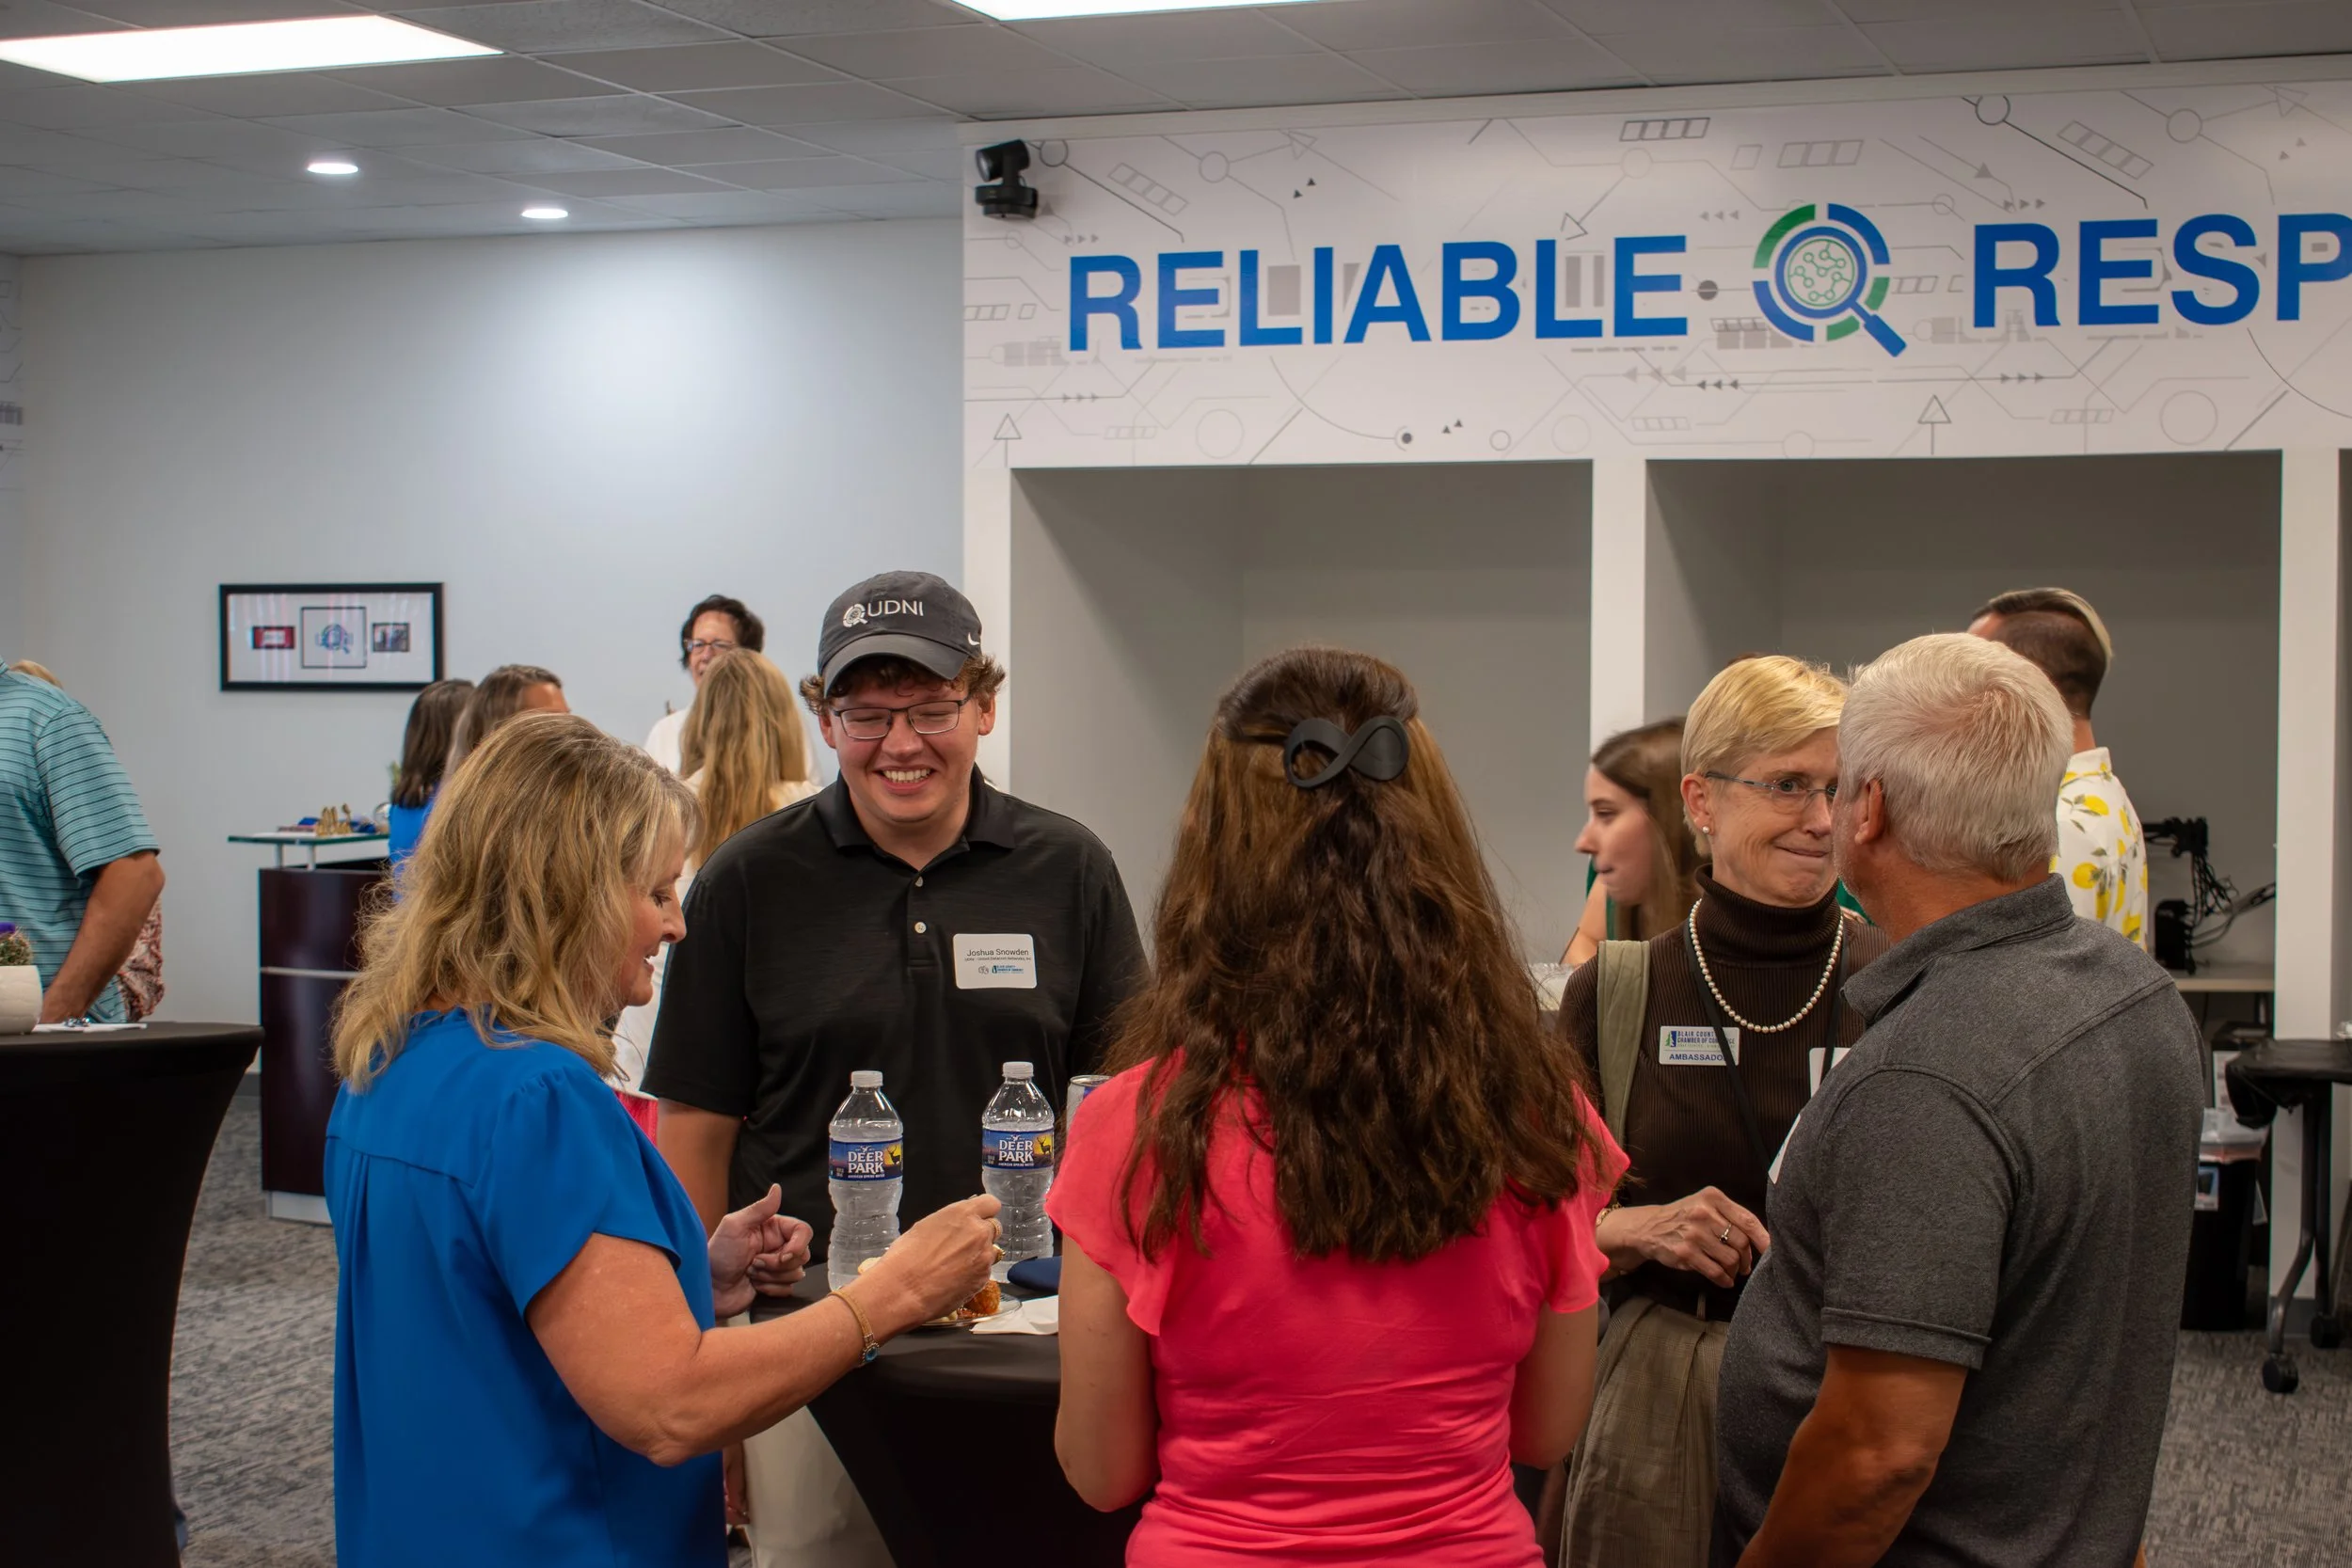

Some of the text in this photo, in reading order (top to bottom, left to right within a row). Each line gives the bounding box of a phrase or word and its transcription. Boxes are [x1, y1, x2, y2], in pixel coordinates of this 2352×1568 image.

[1070, 214, 2352, 351] RELIABLE RESP
[966, 948, 994, 957] Joshua
[999, 1139, 1033, 1150] DEER
[848, 1150, 883, 1163] DEER
[998, 1150, 1034, 1163] PARK
[848, 1162, 884, 1174] PARK
